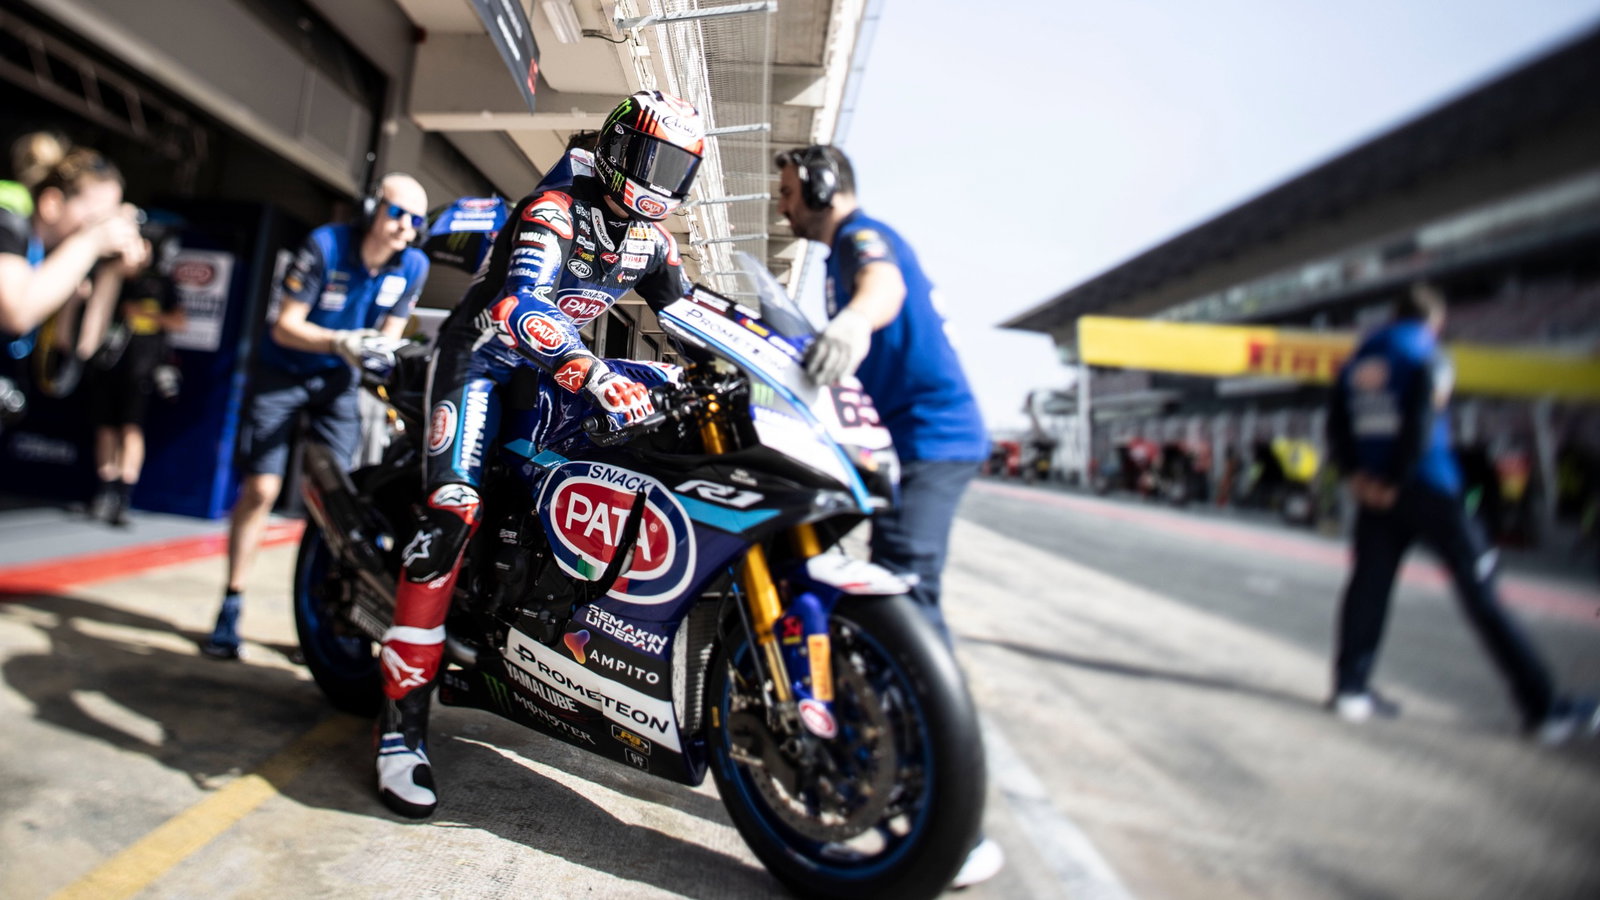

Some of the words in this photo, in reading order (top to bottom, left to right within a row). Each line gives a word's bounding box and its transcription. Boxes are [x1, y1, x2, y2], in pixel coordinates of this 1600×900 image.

[641, 201, 663, 214] PATA
[563, 298, 601, 316] PATA
[583, 290, 606, 301] SNACK
[528, 319, 559, 345] PATA
[590, 465, 652, 493] SNACK
[674, 479, 765, 508] R1
[565, 491, 652, 562] PATA
[588, 604, 668, 647] SEMAKIN
[602, 623, 664, 655] DEPAN
[589, 649, 660, 685] AMPITO
[503, 659, 579, 713] YAMALUBE
[513, 644, 669, 733] PROMETEON
[513, 691, 596, 745] MONSTER
